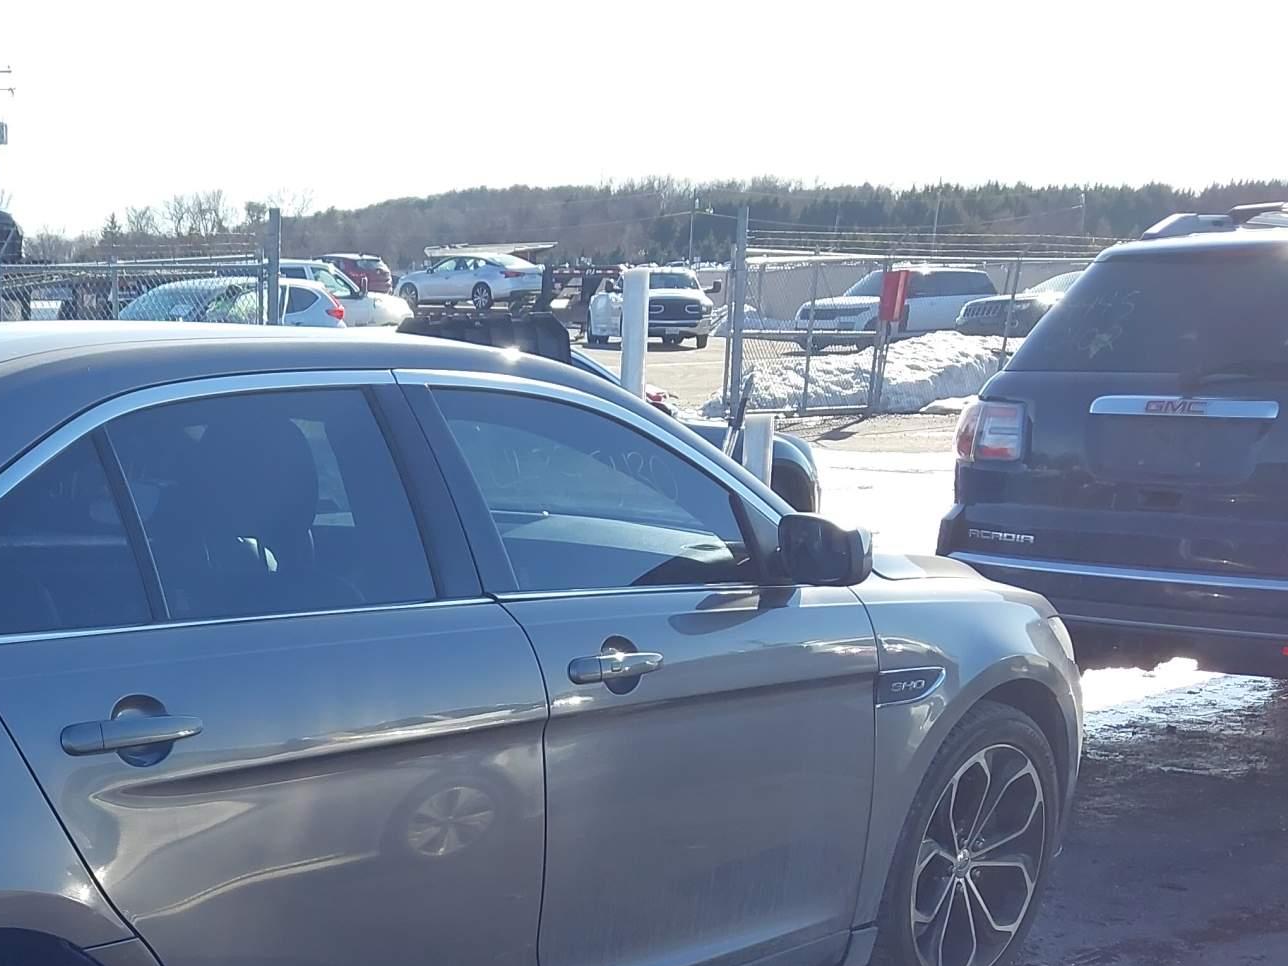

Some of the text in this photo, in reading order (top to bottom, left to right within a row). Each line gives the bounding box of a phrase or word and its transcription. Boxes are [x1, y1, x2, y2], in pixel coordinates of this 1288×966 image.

[1144, 400, 1208, 414] GMC
[968, 528, 1035, 545] ACADIA
[890, 679, 926, 692] SHO
